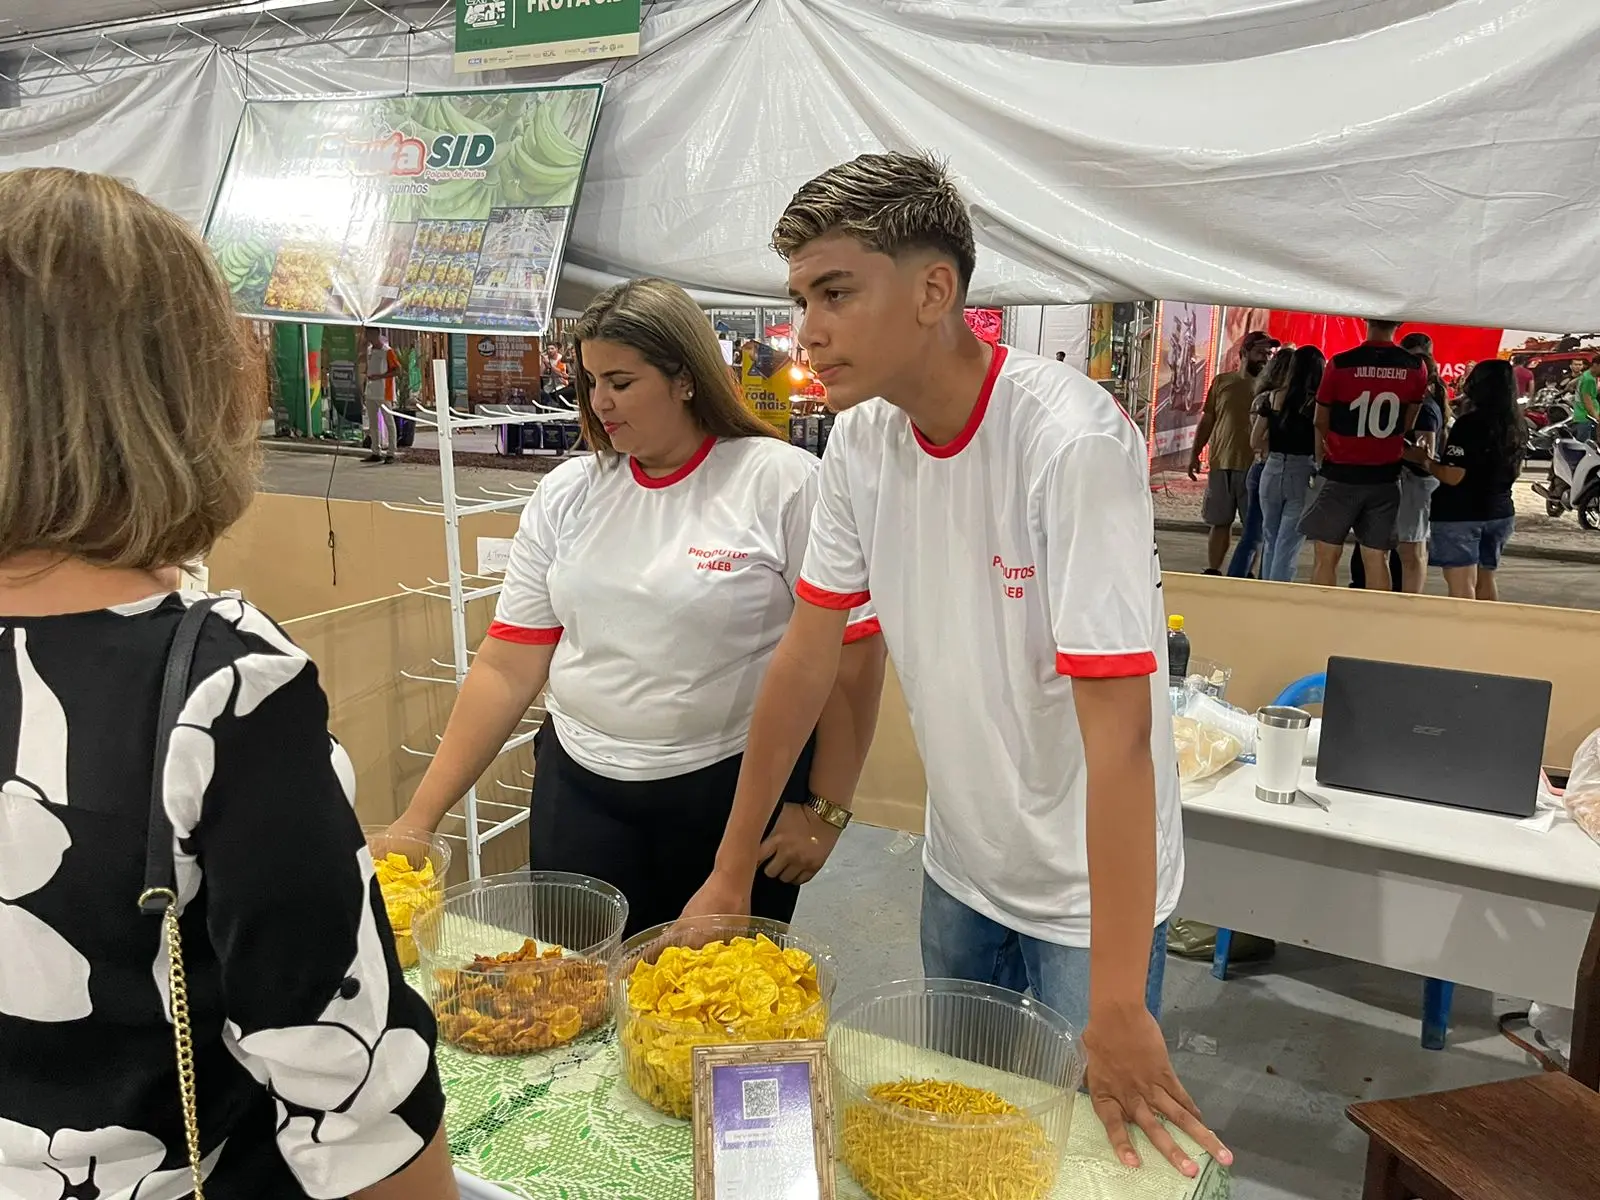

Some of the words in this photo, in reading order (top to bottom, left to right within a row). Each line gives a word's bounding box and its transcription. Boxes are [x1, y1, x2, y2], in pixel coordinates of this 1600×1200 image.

[426, 134, 495, 168] SID
[425, 170, 451, 180] Polpas
[452, 169, 462, 178] de
[463, 169, 486, 178] frutas
[1354, 366, 1376, 378] JULIO
[1376, 367, 1408, 380] COELHO
[755, 399, 787, 410] mais
[1349, 391, 1400, 439] 10
[1412, 725, 1447, 736] acer
